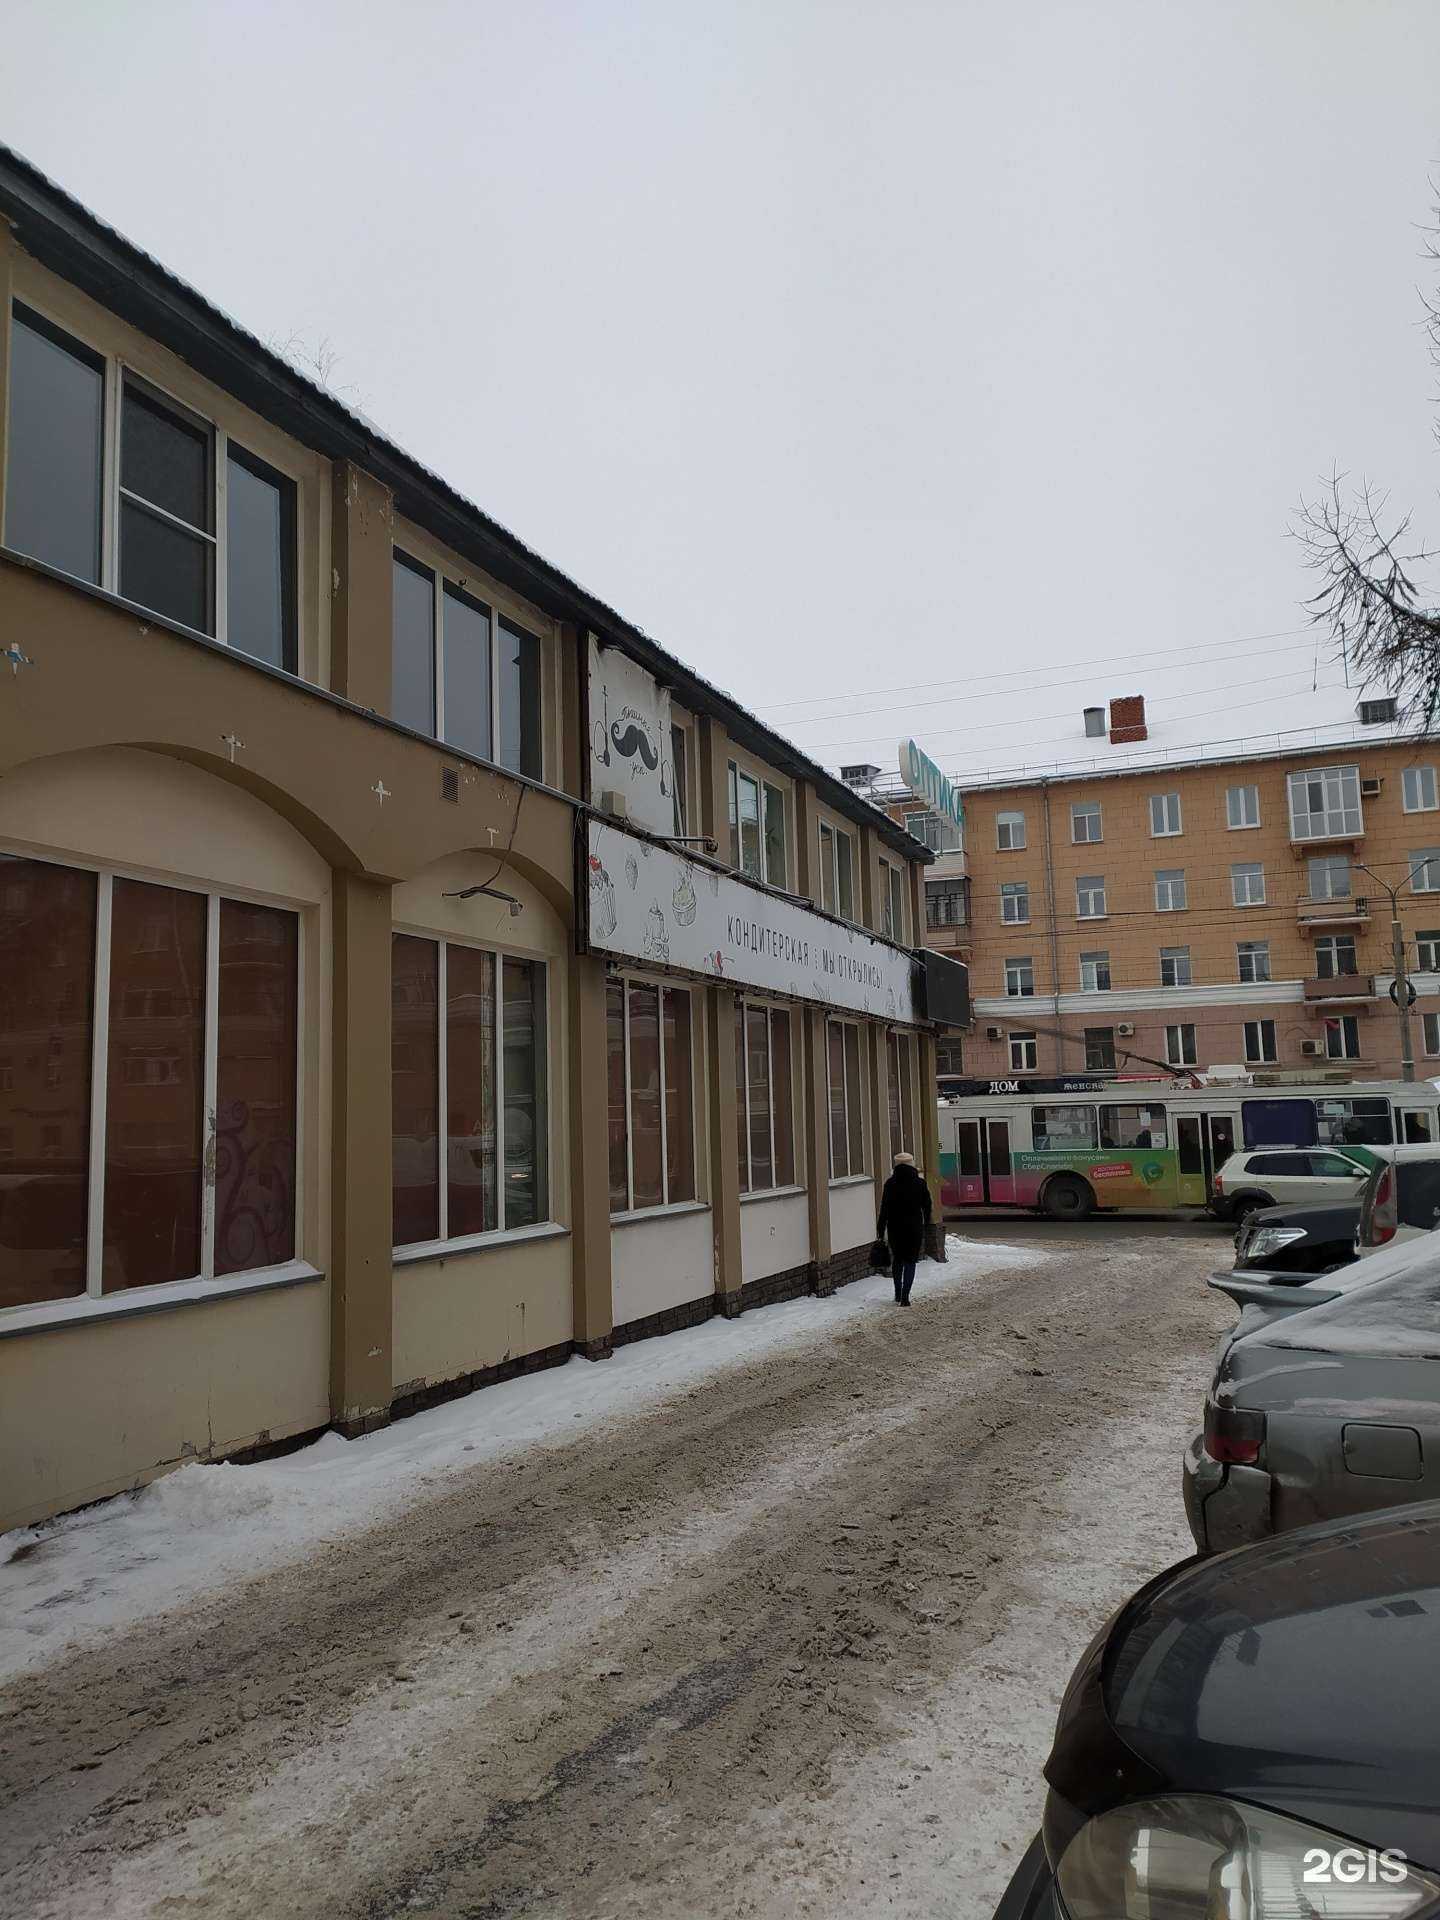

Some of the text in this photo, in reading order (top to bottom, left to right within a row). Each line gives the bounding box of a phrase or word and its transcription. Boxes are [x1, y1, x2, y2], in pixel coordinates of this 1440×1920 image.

[727, 914, 809, 967] КОНДИТЕРСКАЯ
[822, 948, 836, 975] МЫ
[988, 1081, 1020, 1094] ДОМ
